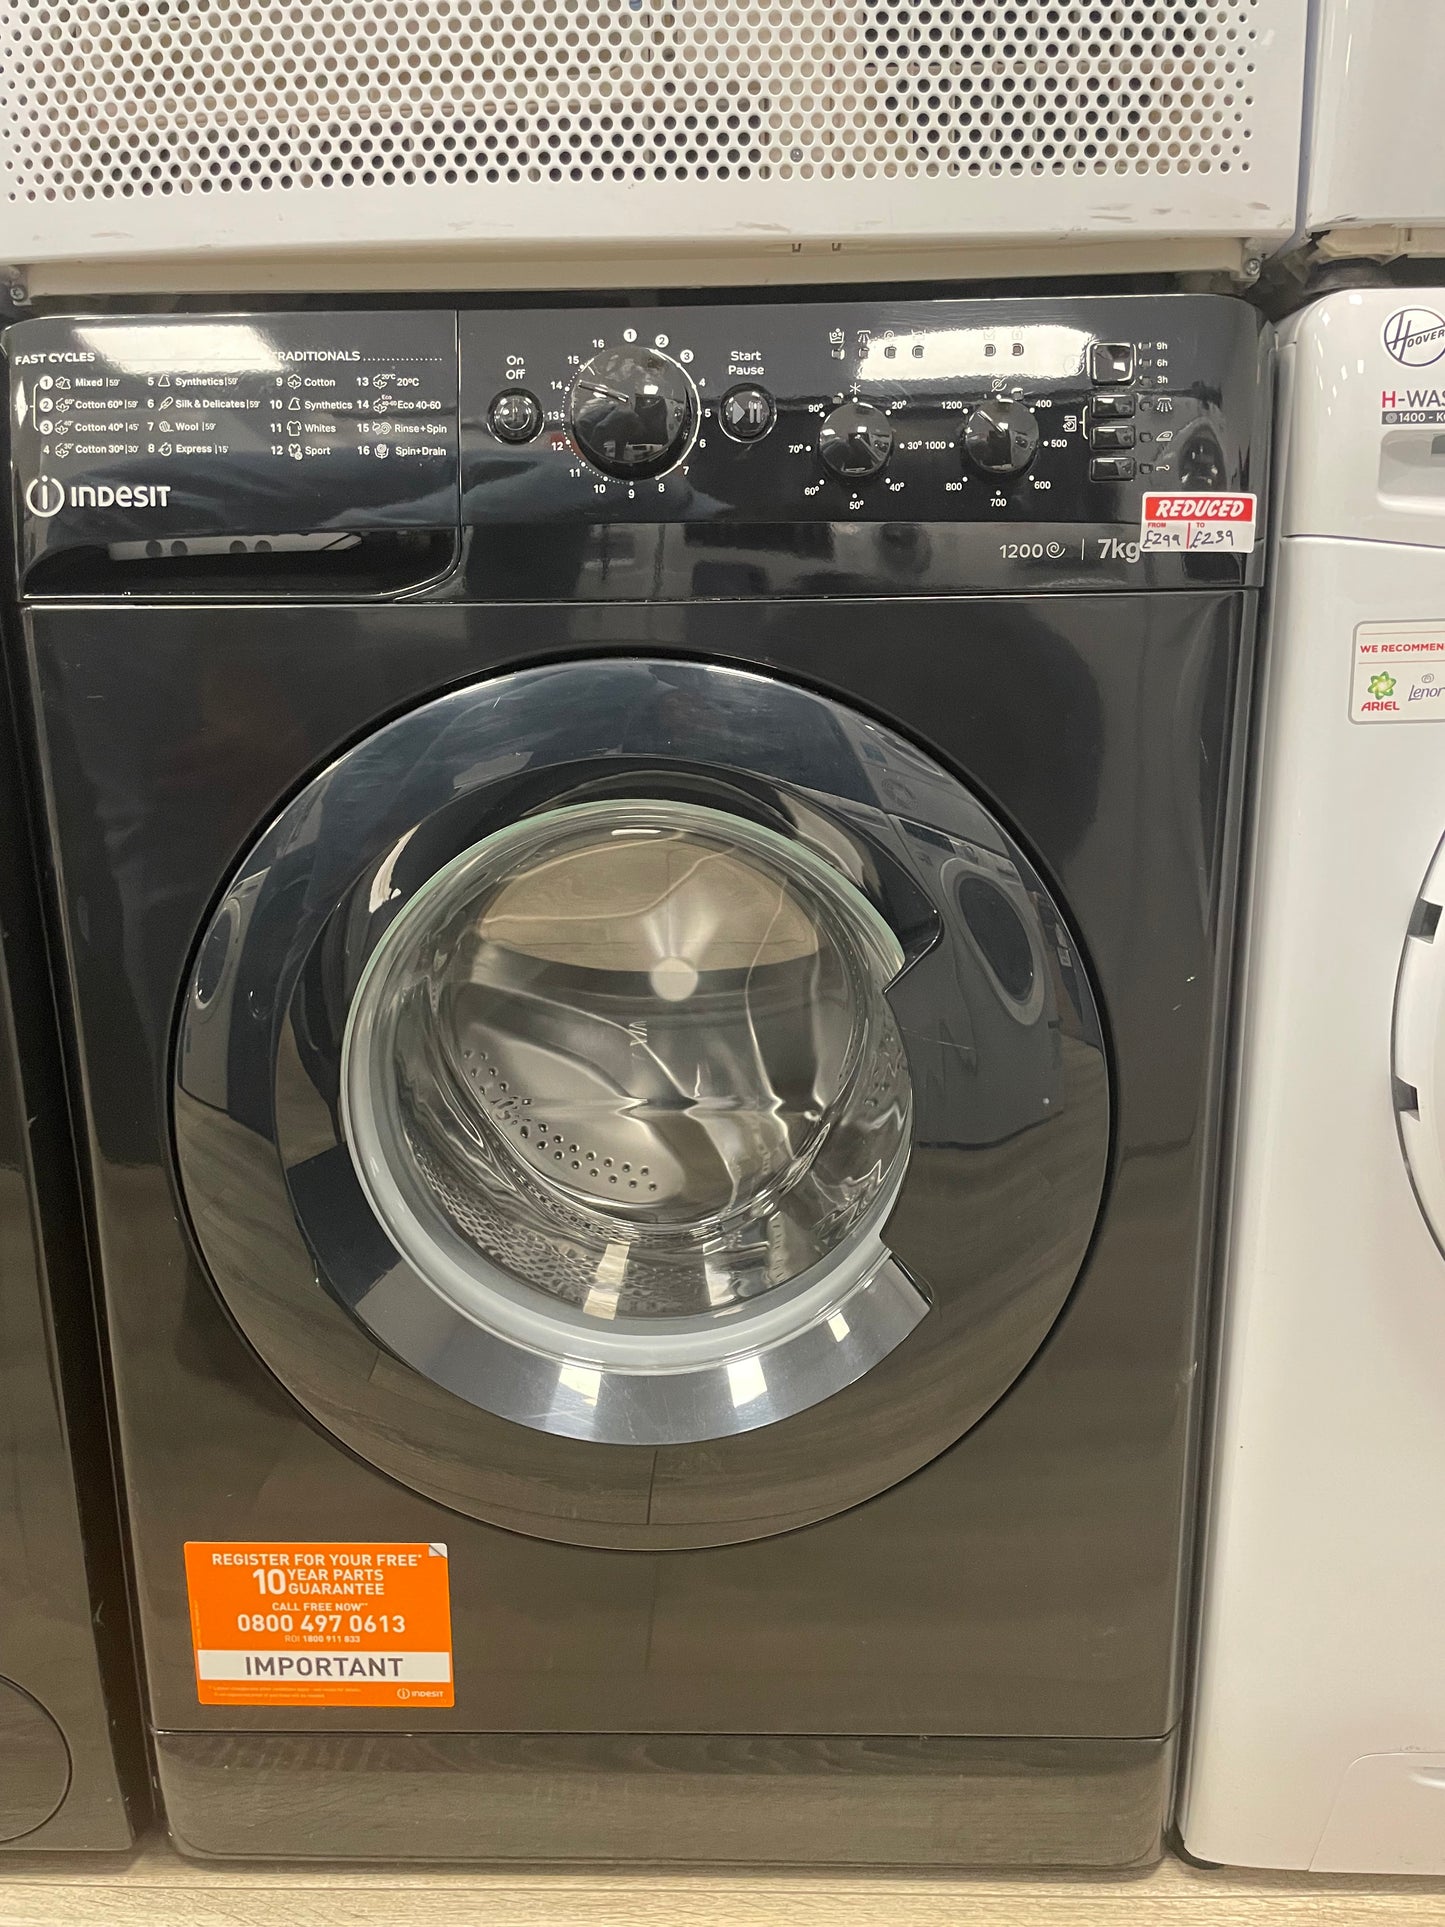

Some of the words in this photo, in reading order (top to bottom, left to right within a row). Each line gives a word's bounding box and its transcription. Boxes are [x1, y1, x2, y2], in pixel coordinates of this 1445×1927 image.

[592, 339, 605, 348] 16
[1156, 342, 1168, 350] 9h
[15, 354, 46, 365] FAST
[49, 352, 95, 363] CYCLES
[506, 355, 524, 365] On
[567, 355, 580, 365] 15
[731, 351, 762, 361] Start
[1156, 358, 1168, 367] 6h
[506, 369, 526, 380] Off
[728, 365, 764, 375] Pause
[76, 378, 103, 387] Mixed
[148, 378, 154, 386] 5
[175, 377, 224, 388] Synthetics
[276, 377, 283, 387] 9
[304, 378, 336, 387] Cotton
[357, 377, 369, 387] 13
[699, 378, 706, 388] 4
[1157, 375, 1168, 384] 3h
[550, 381, 562, 390] 14
[75, 401, 106, 409] Cotton
[147, 399, 154, 408] 6
[175, 400, 193, 408] Silk
[194, 400, 201, 408] &
[203, 399, 245, 409] Delicates
[270, 400, 283, 410] 10
[304, 401, 353, 411] Synthetics
[357, 400, 370, 409] 14
[397, 400, 415, 409] Eco
[416, 400, 441, 410] 40-60
[941, 402, 963, 410] 1200
[1035, 400, 1052, 409] 400
[547, 411, 559, 420] 13
[705, 408, 711, 417] 5
[1399, 412, 1427, 422] 1400
[75, 423, 107, 432] Cotton
[147, 422, 154, 431] 7
[175, 422, 199, 431] Wool
[270, 423, 282, 433] 11
[304, 423, 337, 433] Whites
[357, 423, 369, 433] 15
[551, 442, 564, 451] 12
[700, 440, 706, 448] 6
[925, 441, 946, 450] 1000
[1050, 439, 1067, 448] 500
[43, 445, 50, 454] 4
[75, 445, 107, 453] Cotton
[148, 444, 155, 453] 8
[177, 445, 213, 455] Express
[271, 446, 284, 455] 12
[305, 446, 331, 456] Sport
[357, 446, 370, 455] 16
[570, 468, 581, 477] 11
[683, 466, 690, 475] 7
[593, 484, 606, 493] 10
[658, 483, 665, 493] 8
[945, 483, 962, 491] 800
[1034, 481, 1051, 490] 600
[629, 490, 635, 499] 9
[990, 498, 1007, 507] 700
[1155, 499, 1245, 518] REDUCED
[1189, 530, 1234, 549] £239
[999, 543, 1044, 559] 1200
[1097, 538, 1140, 563] 7kg
[1360, 645, 1379, 653] WE
[1361, 701, 1401, 712] ARIEL
[212, 1553, 290, 1566] REGISTER
[294, 1554, 326, 1566] FOR
[329, 1554, 372, 1566] YOUR
[252, 1568, 286, 1595] 10
[288, 1569, 329, 1581] YEAR
[333, 1569, 384, 1581] PARTS
[288, 1583, 385, 1596] GUARANTEE
[272, 1602, 300, 1611] CALL
[303, 1602, 332, 1611] FREE
[237, 1613, 293, 1632] 0800
[300, 1614, 342, 1633] 497
[349, 1615, 406, 1633] 0613
[303, 1635, 324, 1643] 1800
[326, 1635, 342, 1643] 911
[245, 1656, 404, 1677] IMPORTANT
